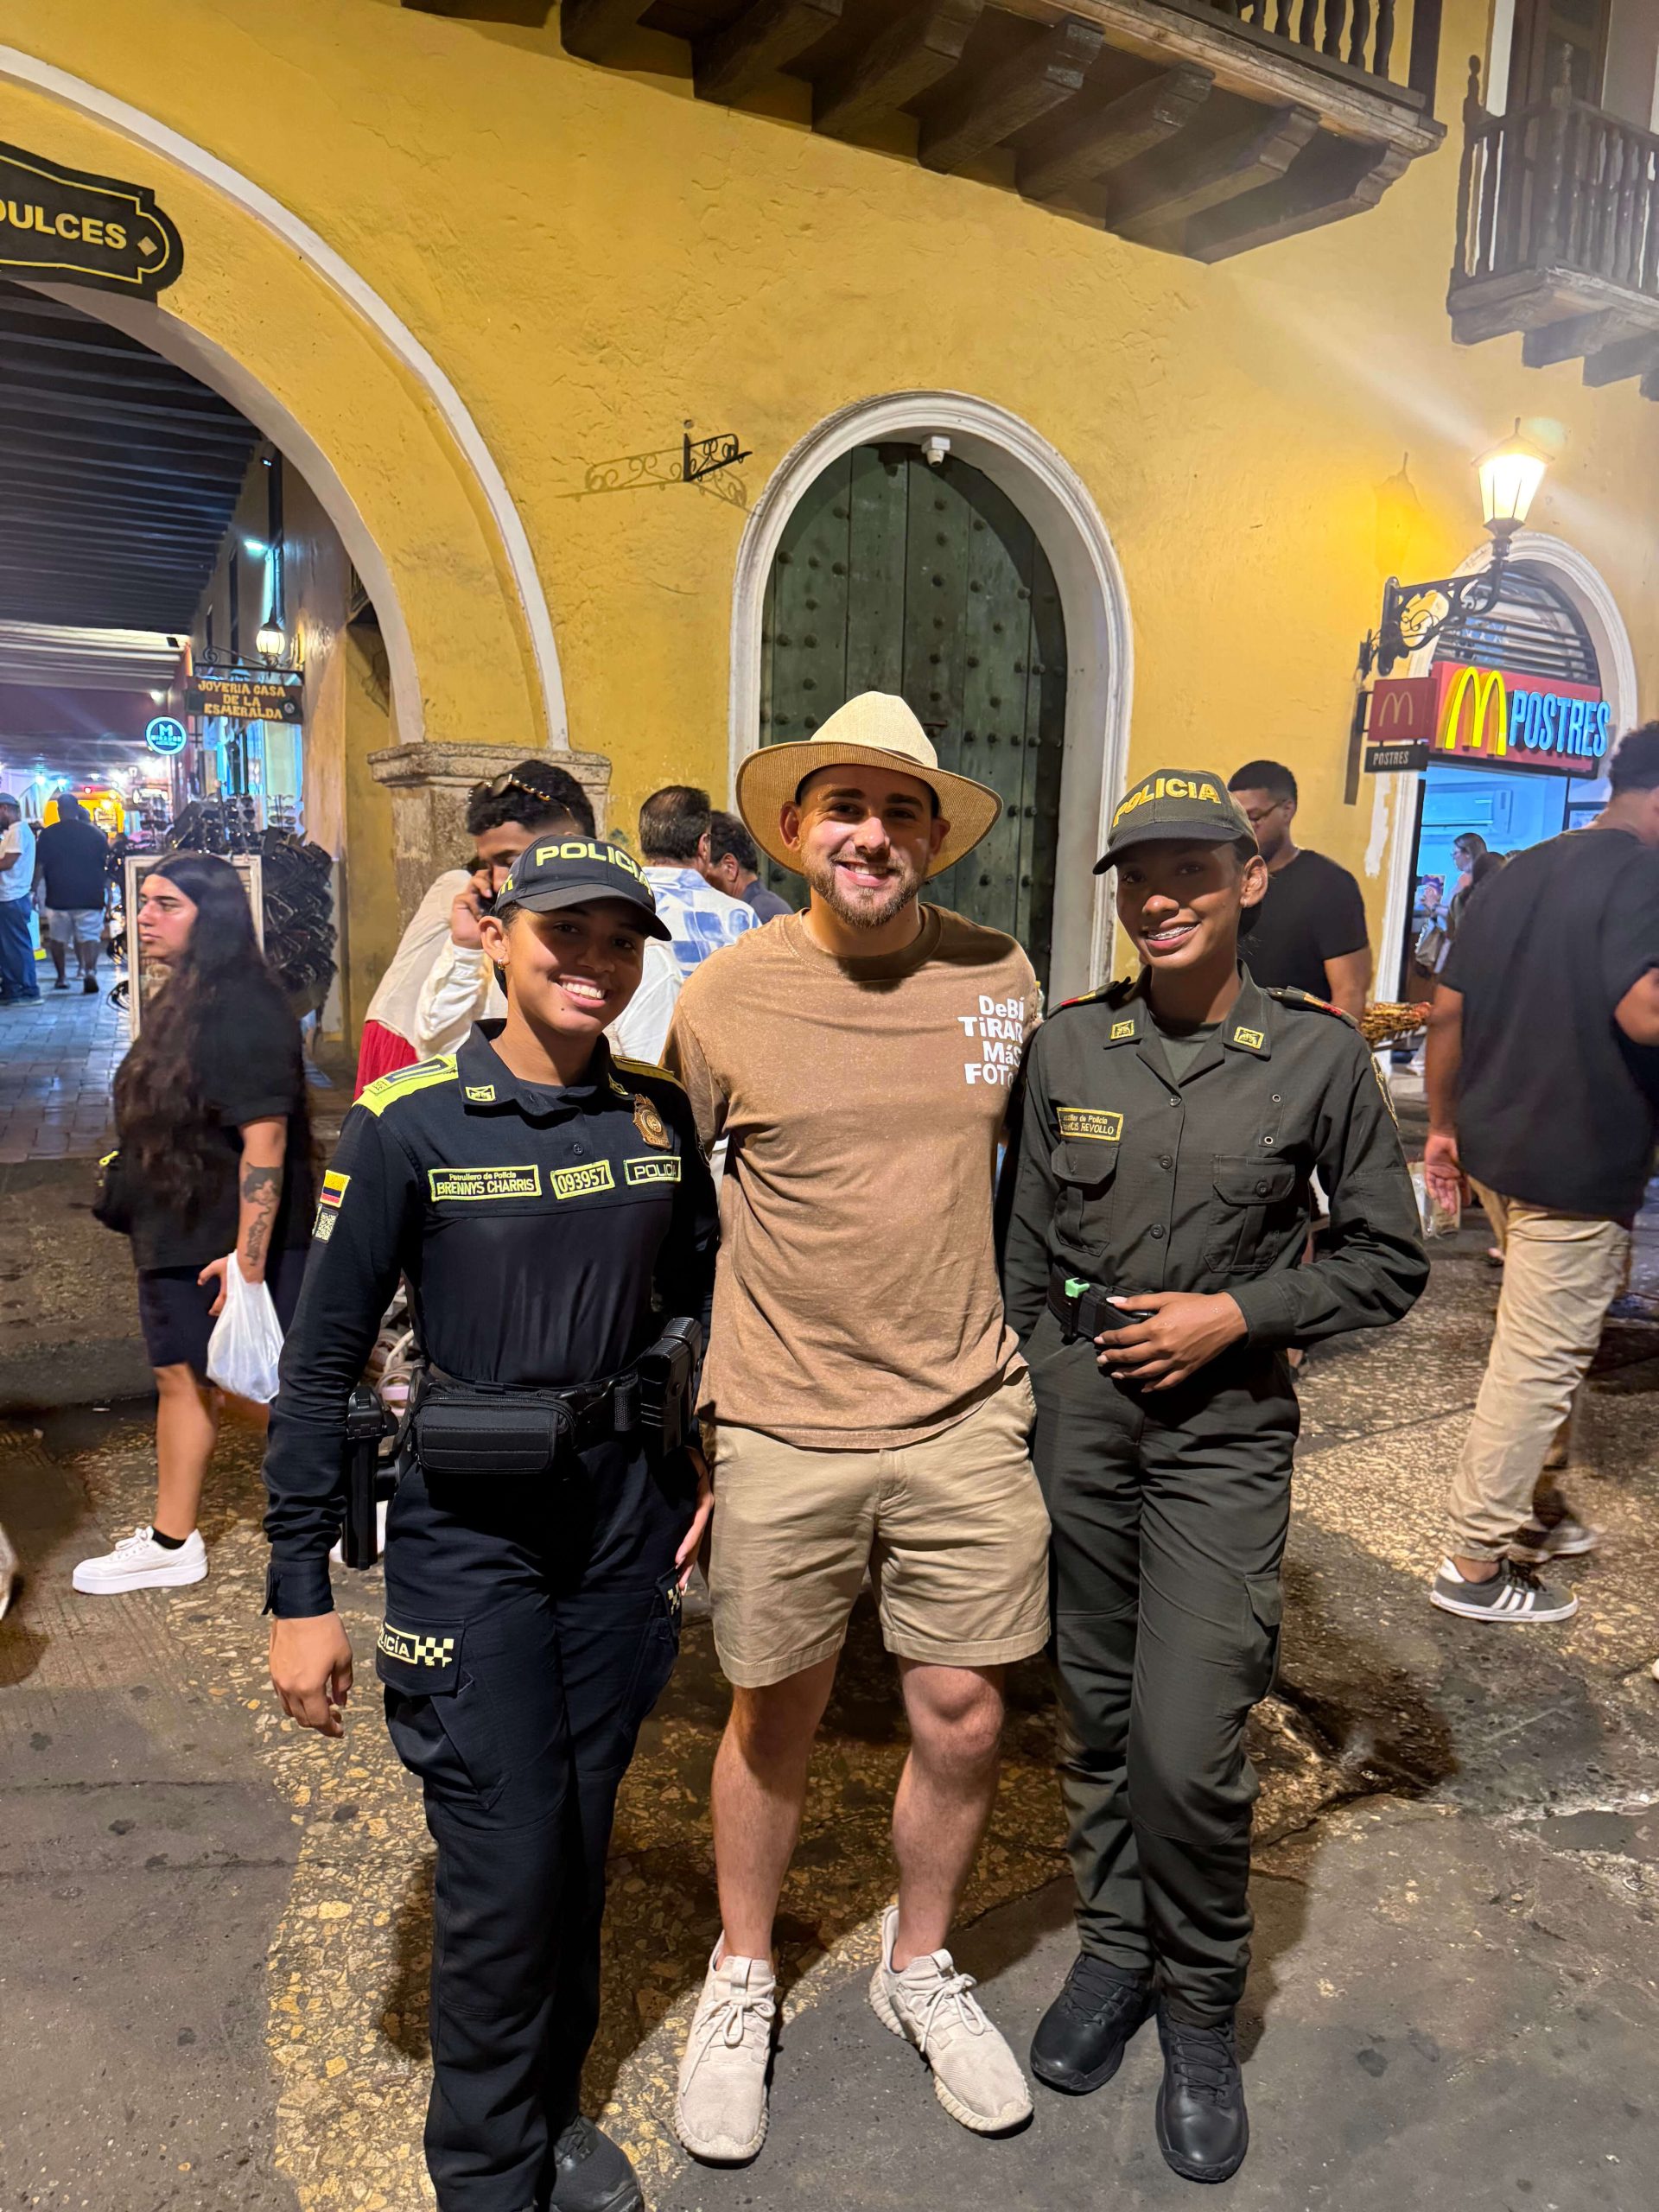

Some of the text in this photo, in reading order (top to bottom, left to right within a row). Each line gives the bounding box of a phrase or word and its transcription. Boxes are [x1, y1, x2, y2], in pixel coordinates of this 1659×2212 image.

[0, 199, 127, 250] ULCES
[198, 680, 286, 697] JOYERIA CASA
[223, 694, 261, 708] DE LA
[204, 703, 283, 720] ESMERALDA
[1508, 690, 1611, 758] POSTRES
[1373, 751, 1409, 766] POSTRES
[1113, 778, 1222, 828] POLICIA
[536, 842, 654, 898] POLICIA
[1080, 1122, 1115, 1135] REVOLLO
[483, 1172, 493, 1180] de
[557, 1166, 607, 1192] 093957
[436, 1179, 535, 1196] BRENNYS CHARRIS
